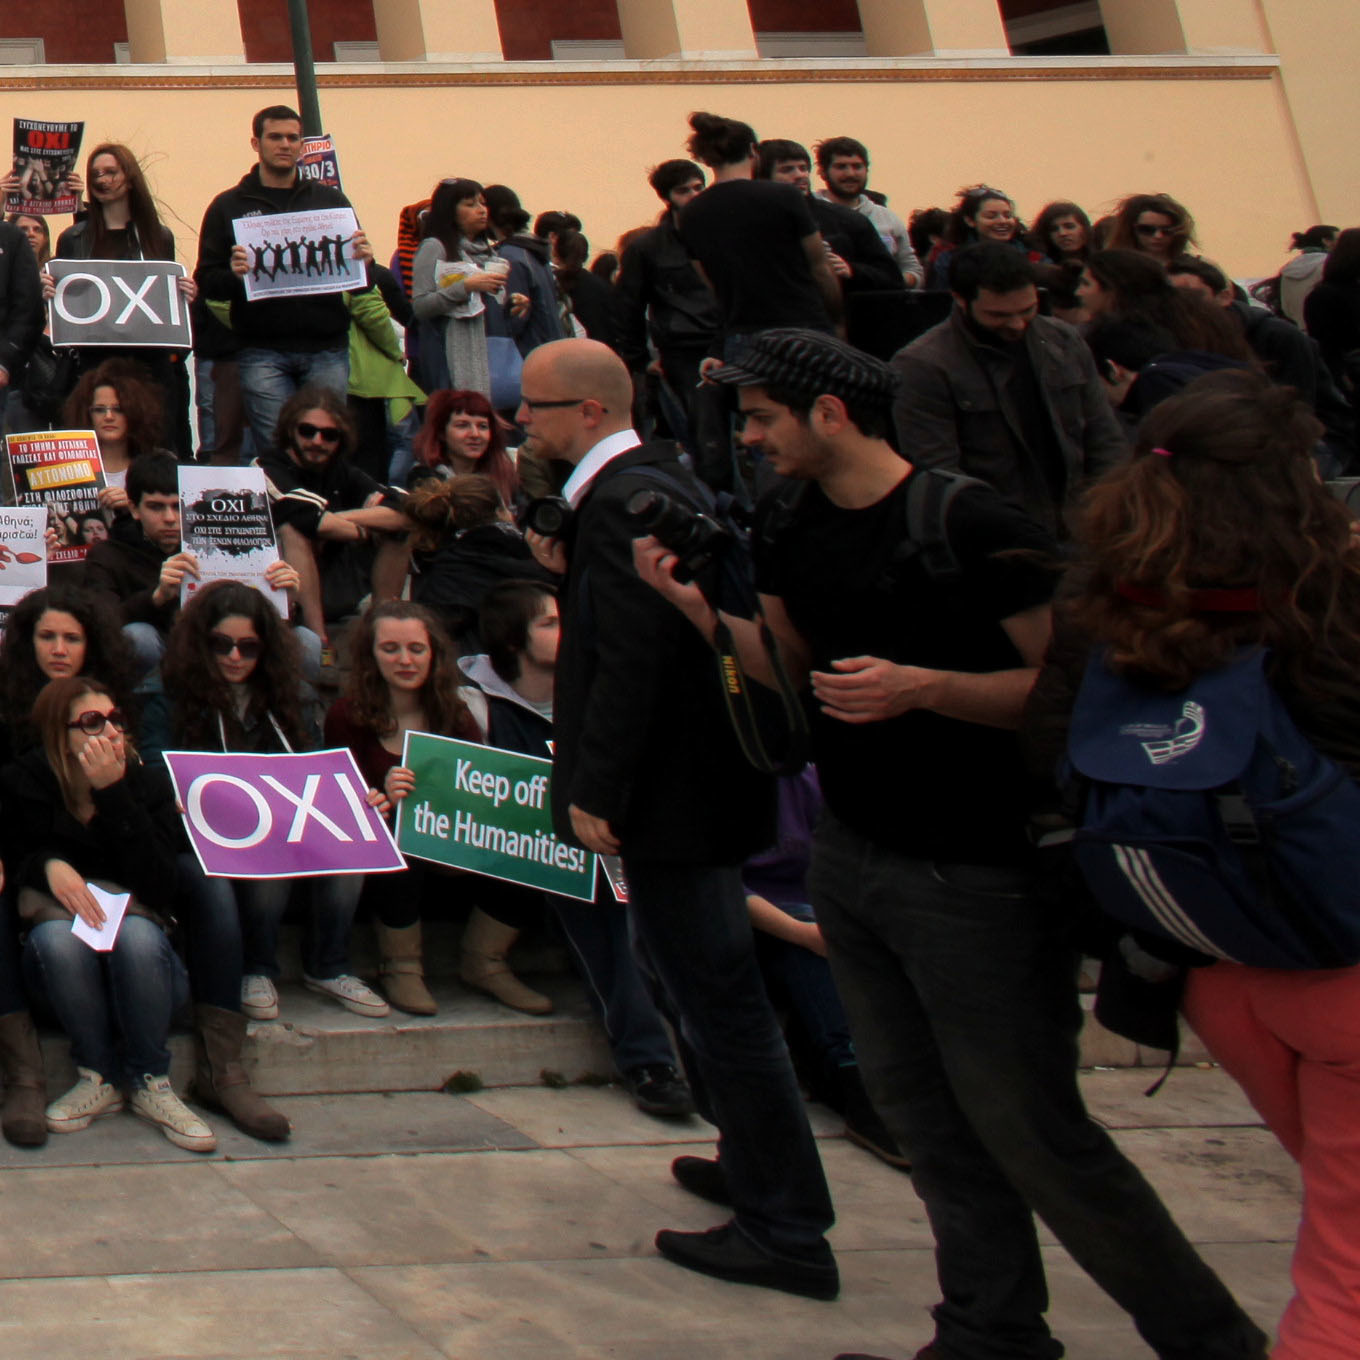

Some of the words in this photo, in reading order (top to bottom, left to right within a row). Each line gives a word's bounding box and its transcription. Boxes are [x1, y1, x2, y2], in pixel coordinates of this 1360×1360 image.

[28, 130, 70, 149] ΟΧΙ
[53, 272, 182, 326] ΟΧΙ
[30, 463, 91, 486] ΑΥΤΟΝΟΜΟ
[211, 499, 245, 512] ΟΧΙ
[455, 758, 510, 808] Keep
[514, 775, 548, 809] off
[186, 771, 378, 849] ΟΧΙ
[414, 800, 449, 838] the
[453, 809, 585, 873] Humanities!
